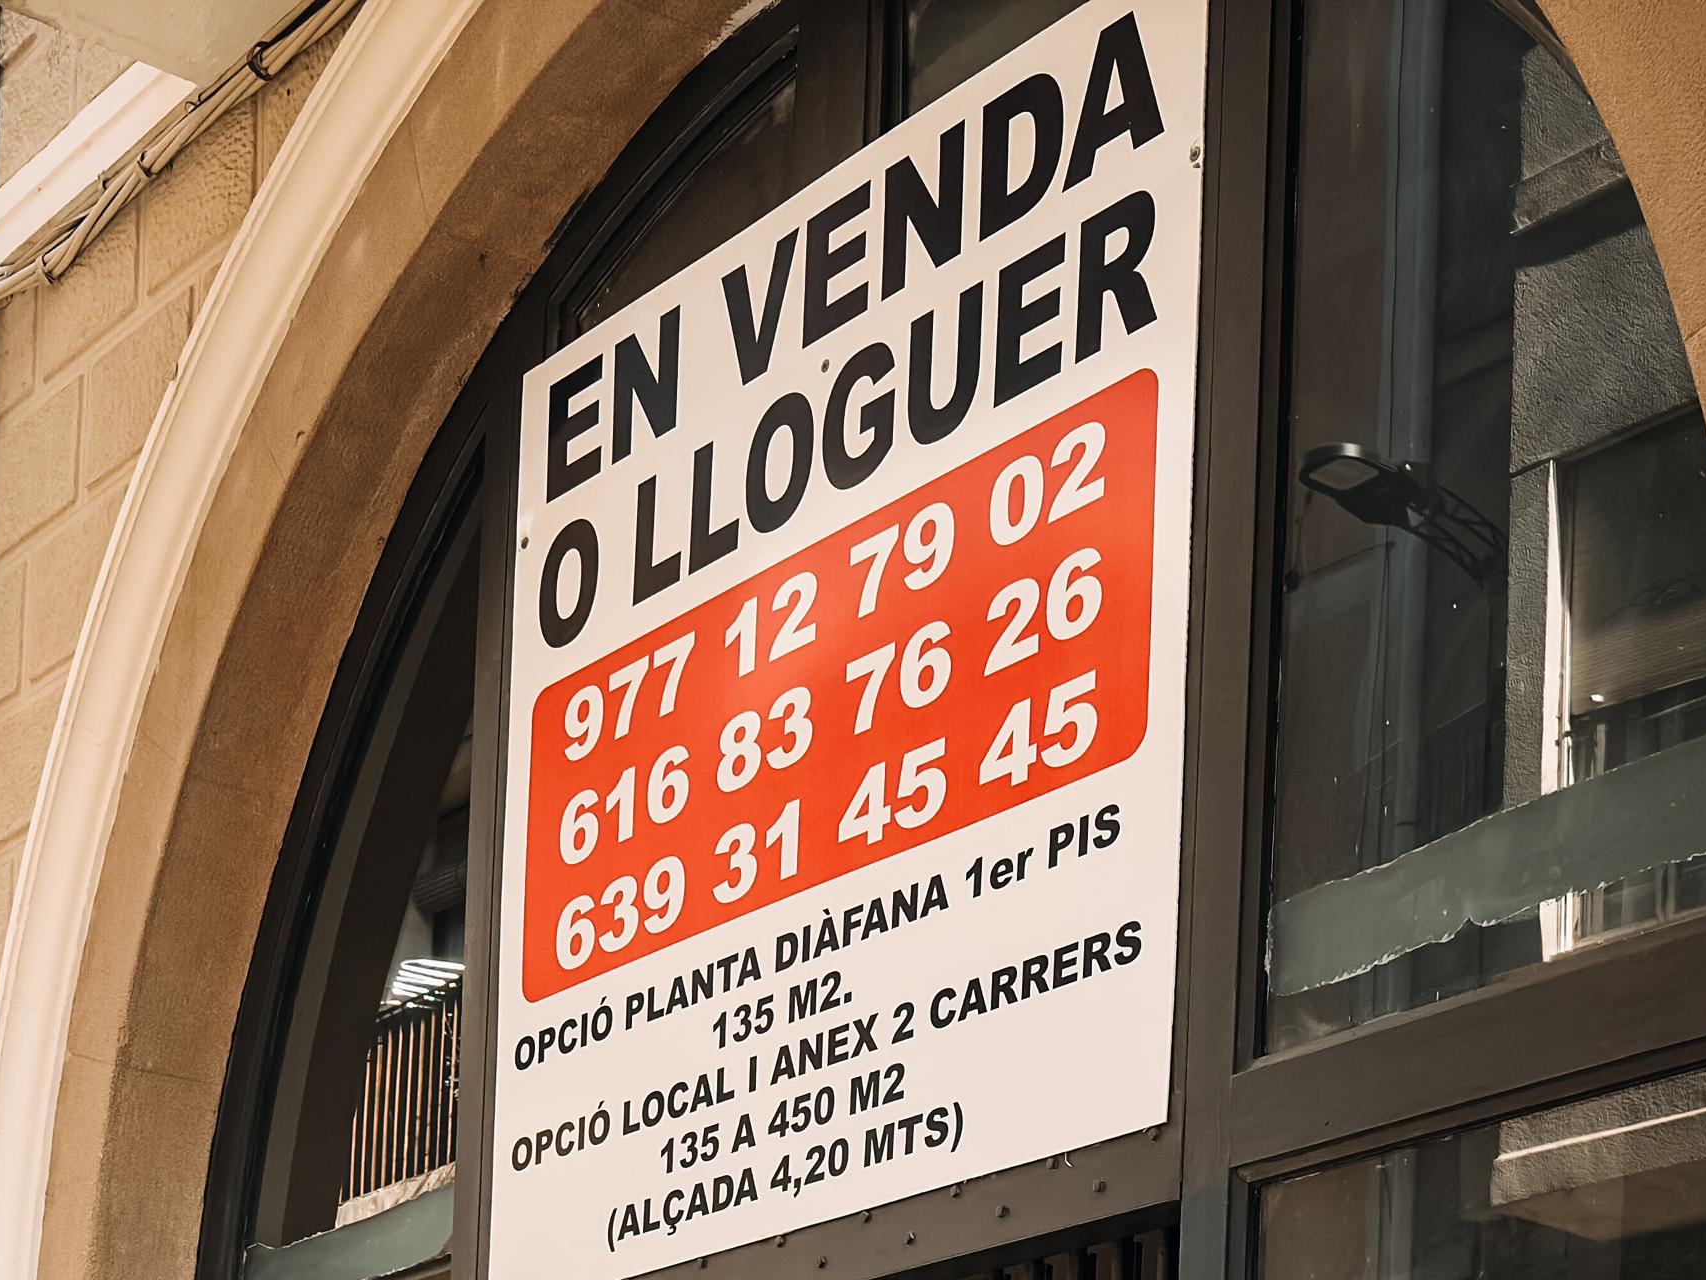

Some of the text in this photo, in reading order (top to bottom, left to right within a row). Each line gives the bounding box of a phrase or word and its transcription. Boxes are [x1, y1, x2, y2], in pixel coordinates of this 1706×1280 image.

[545, 11, 1165, 504] EN VENDA
[538, 191, 1158, 649] O LLOGUER
[559, 548, 1103, 865] 616 83 76 26
[564, 422, 1106, 762] 977 12 79 02
[514, 804, 1121, 1071] OPCIÓ PLANTA DIÀFANA 1er PIS
[555, 670, 1098, 970] 639 31 45 45
[511, 920, 1142, 1172] OPCIÓ LOCAL I ANEX 2 CARRERS
[660, 1062, 905, 1174] 135 A 450 M2
[712, 970, 853, 1049] 135 M2.
[607, 1101, 964, 1253] (ALÇADA 4,20 MTS)
